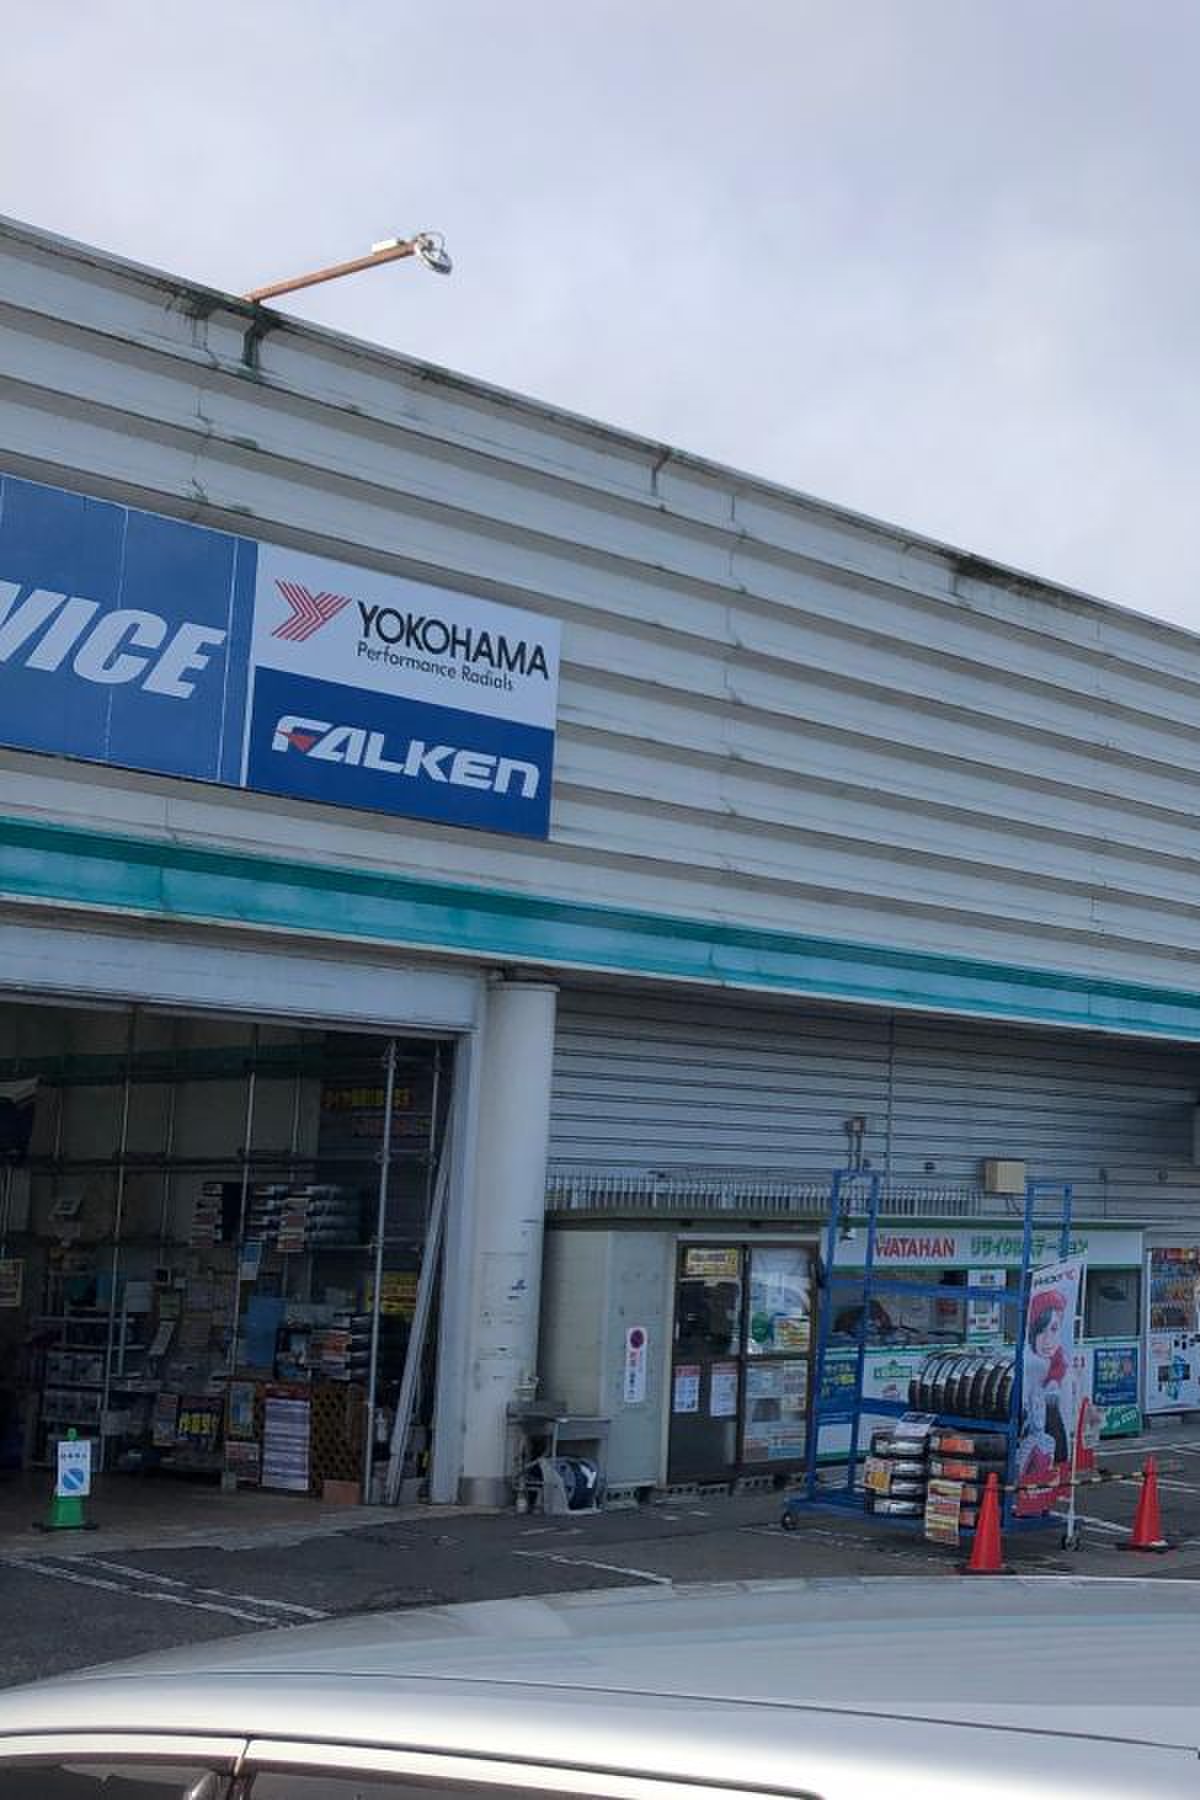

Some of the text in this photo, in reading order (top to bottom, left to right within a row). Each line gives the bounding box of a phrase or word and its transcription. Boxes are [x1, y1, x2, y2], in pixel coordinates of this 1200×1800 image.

[357, 600, 549, 680] YOKOHAMA
[357, 640, 513, 691] Performance Radials
[272, 716, 540, 800] FALKEN
[875, 1237, 956, 1258] WATAHAN
